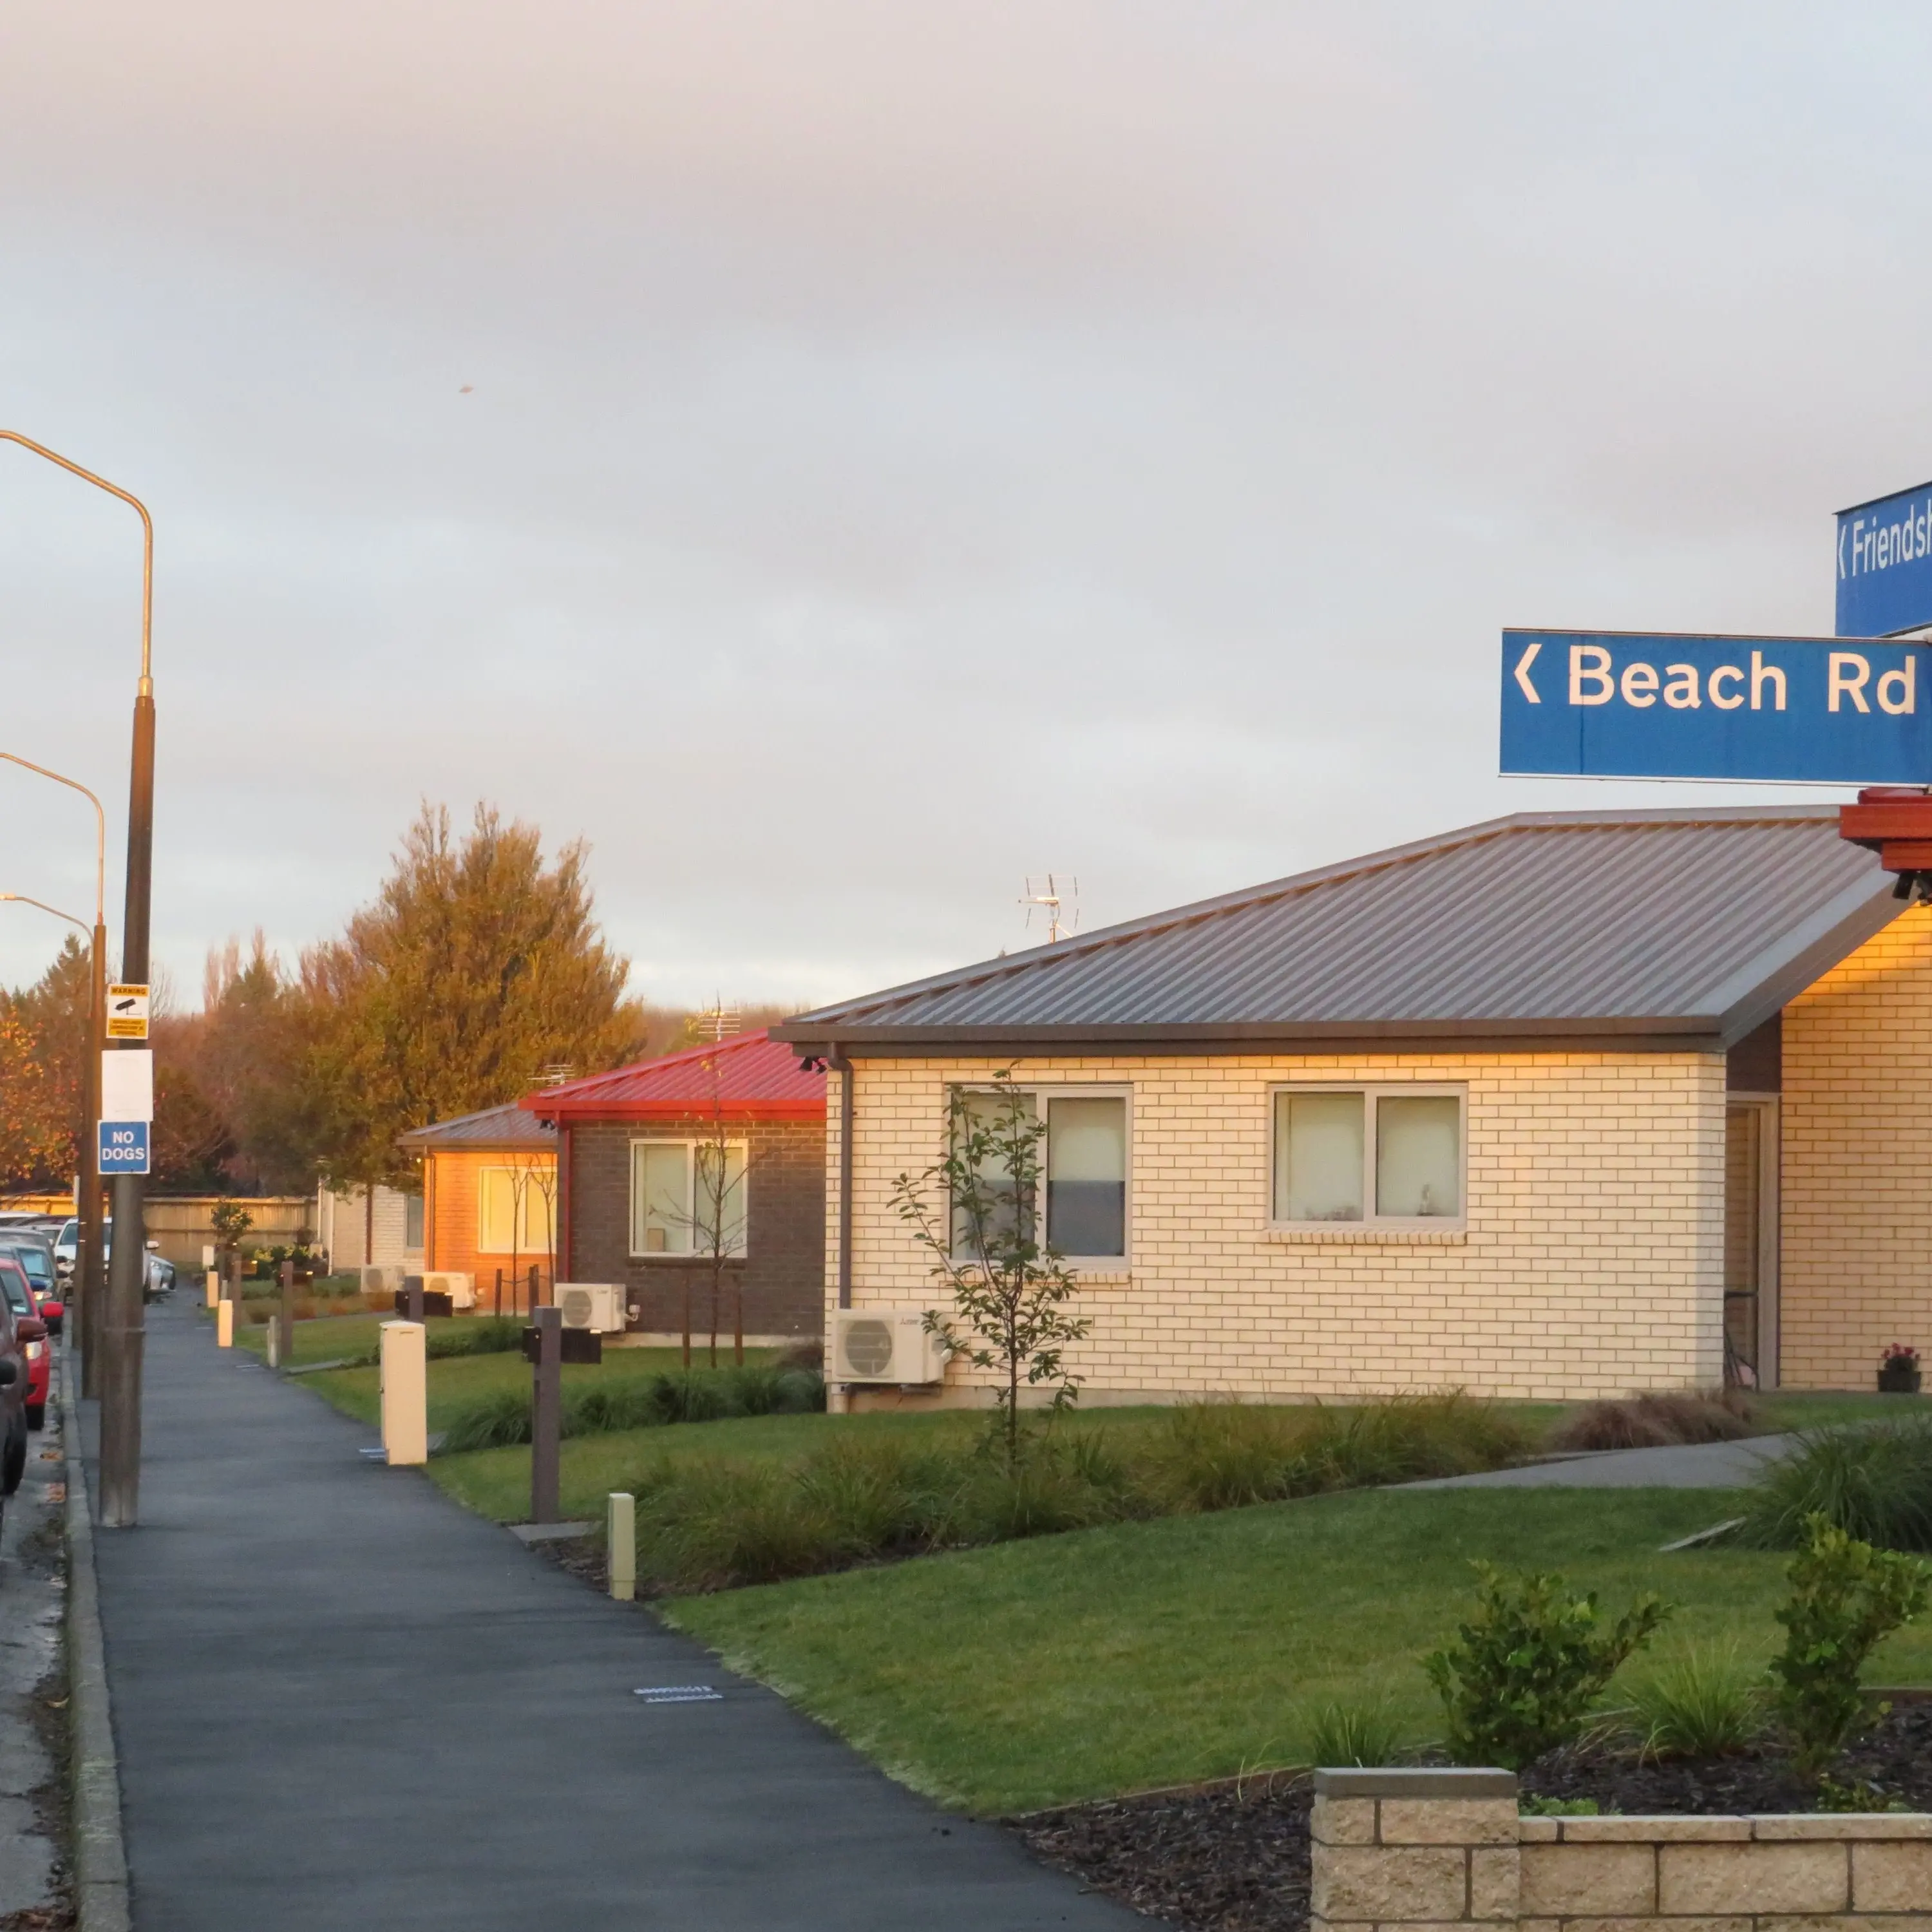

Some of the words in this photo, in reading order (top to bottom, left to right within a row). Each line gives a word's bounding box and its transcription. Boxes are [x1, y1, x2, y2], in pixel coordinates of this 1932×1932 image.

[1569, 645, 1786, 711] Beach
[1827, 652, 1916, 714] Rd
[113, 1131, 134, 1144] NO
[102, 1148, 145, 1160] DOGS
